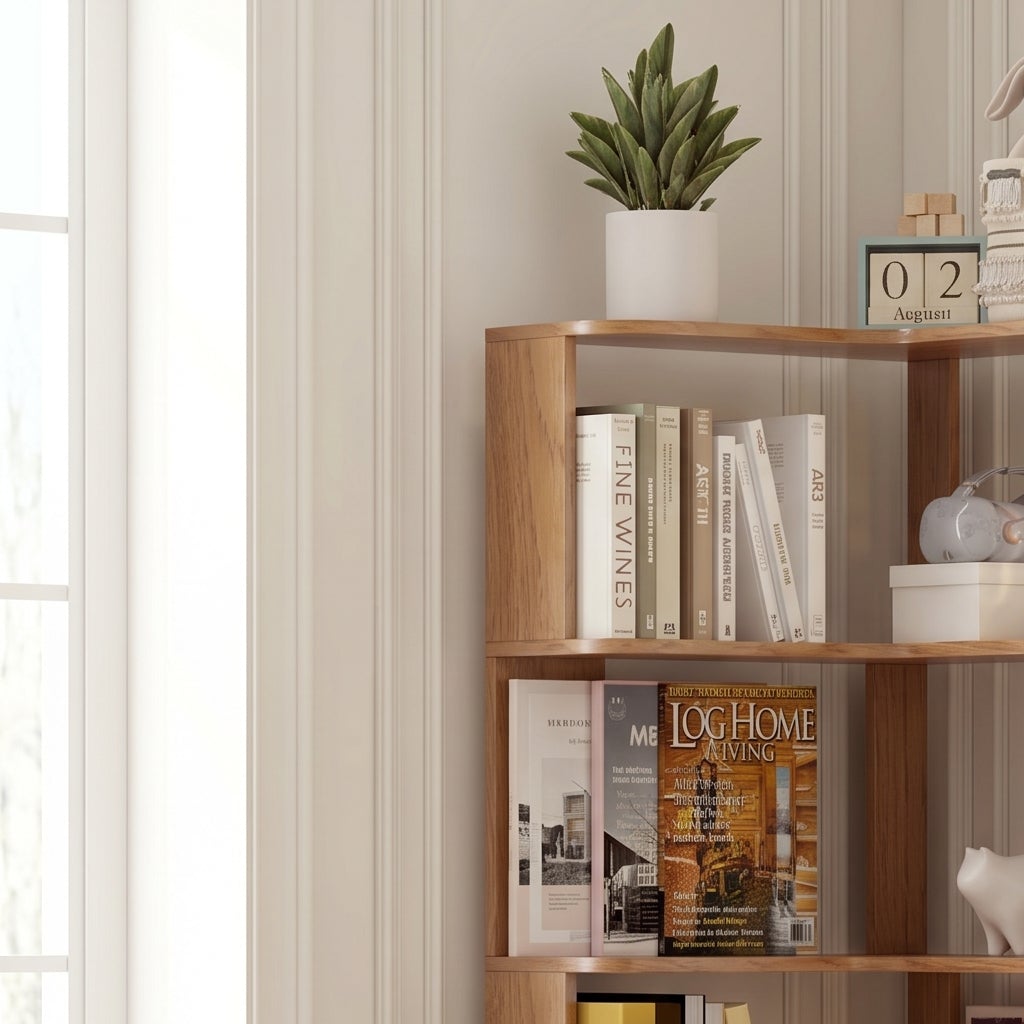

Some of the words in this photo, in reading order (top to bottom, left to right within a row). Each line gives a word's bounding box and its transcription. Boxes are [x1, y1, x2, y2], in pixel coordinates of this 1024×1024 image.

[615, 445, 632, 506] FINE
[811, 468, 824, 503] AR3
[615, 516, 632, 609] WINES
[669, 702, 726, 748] LOG
[731, 702, 815, 741] HOME
